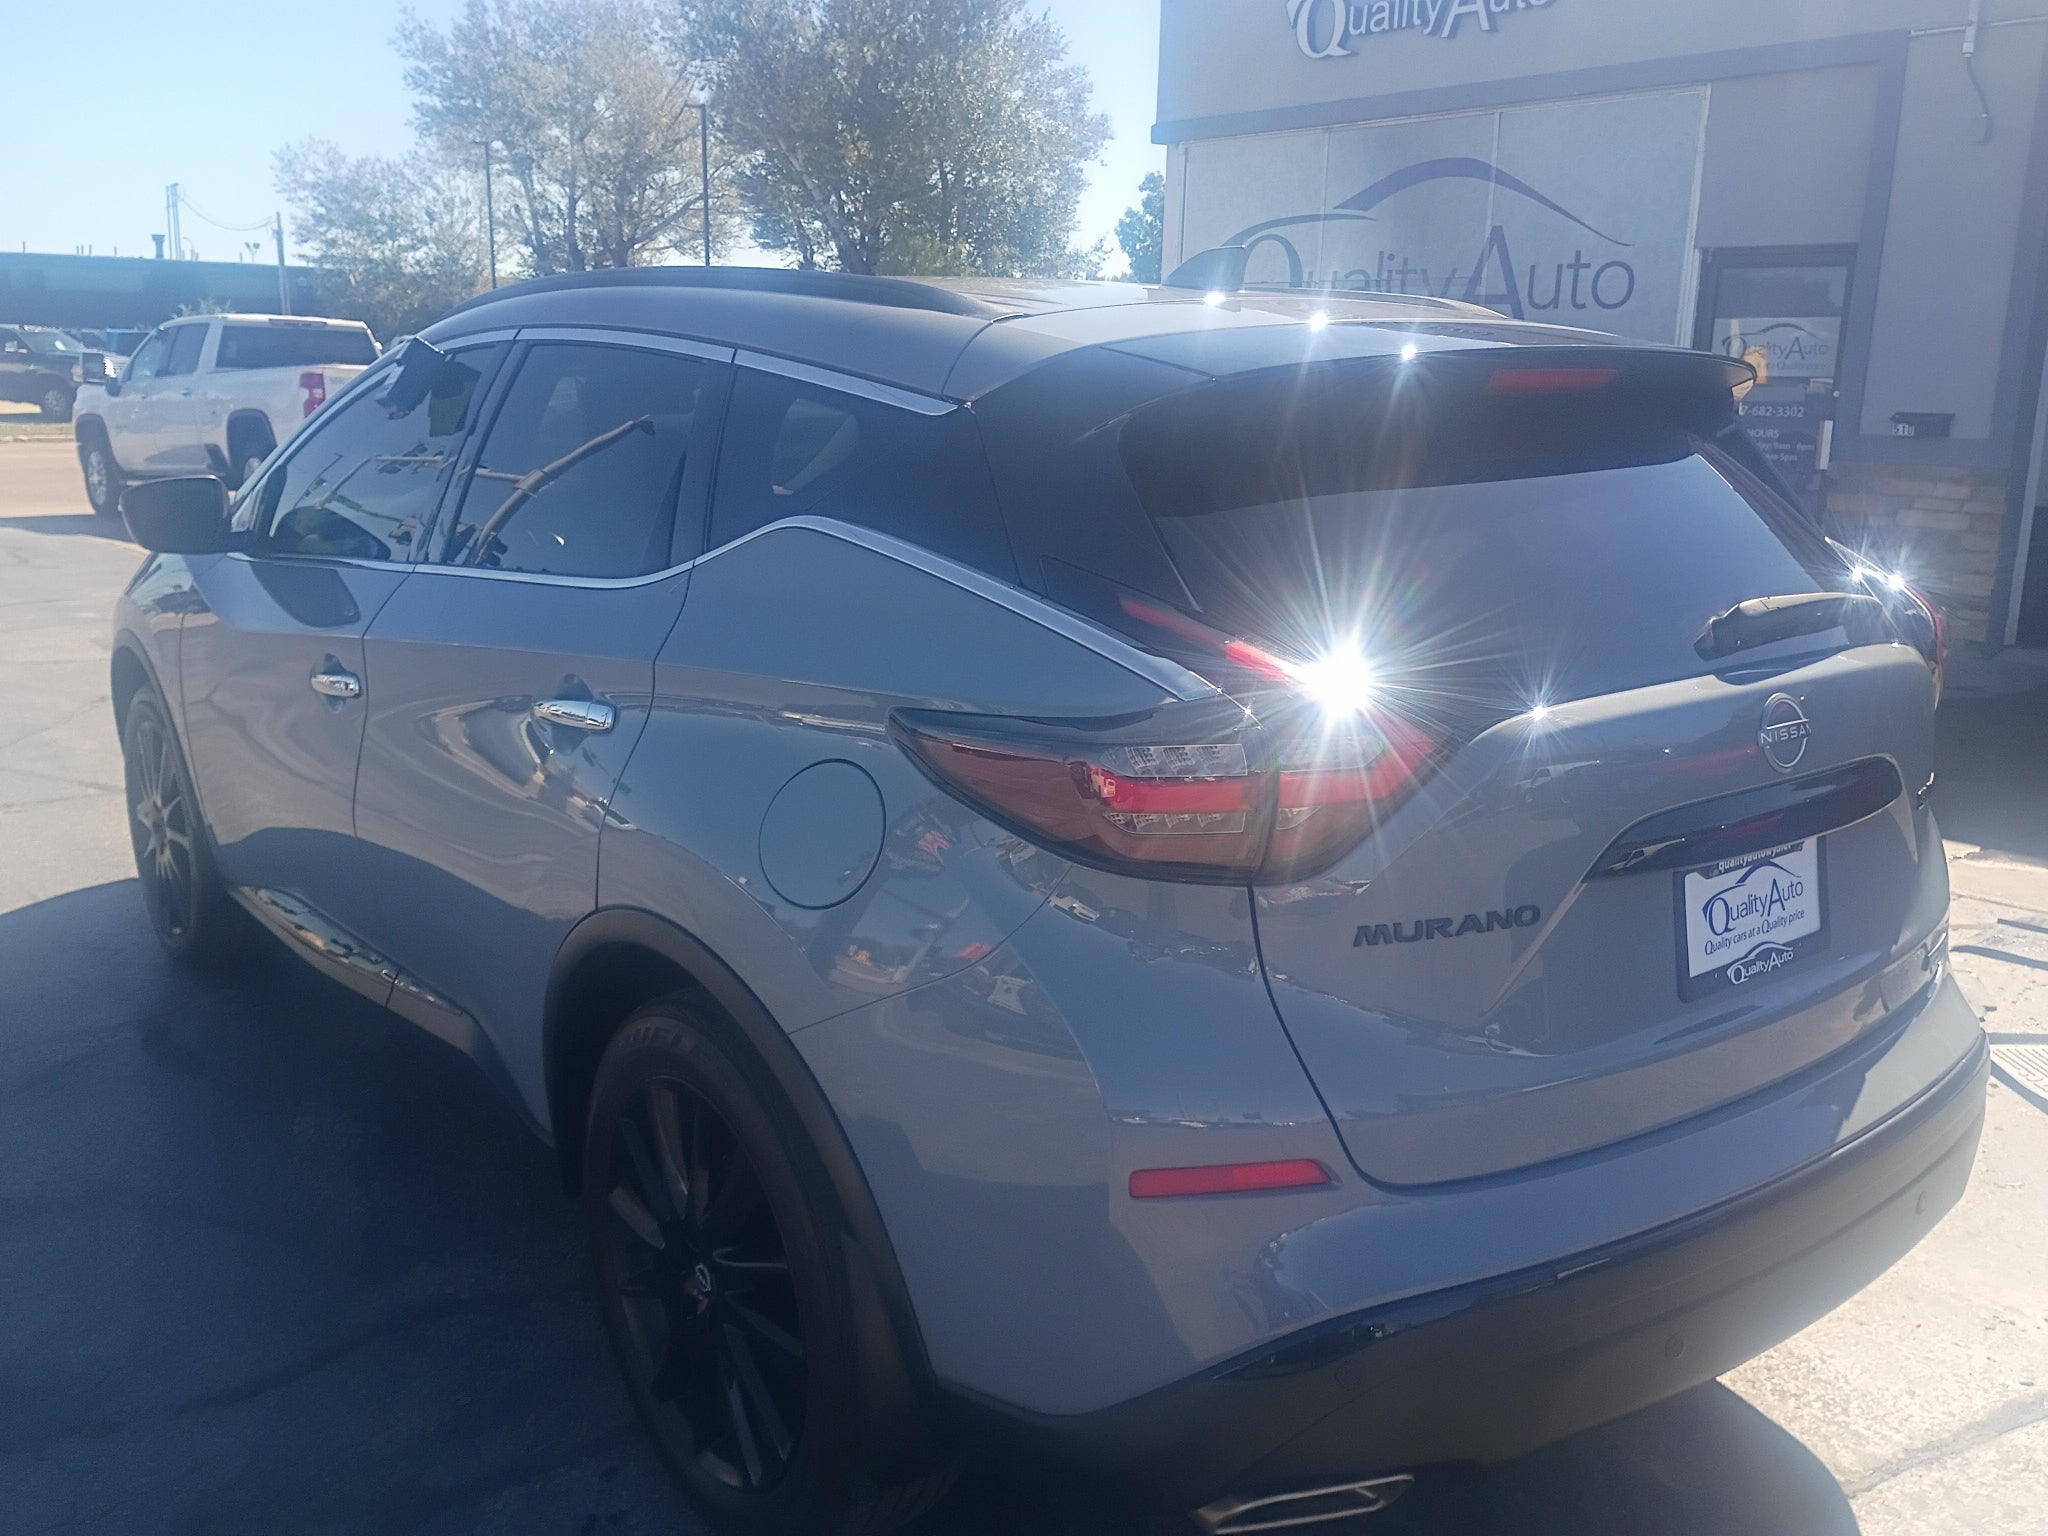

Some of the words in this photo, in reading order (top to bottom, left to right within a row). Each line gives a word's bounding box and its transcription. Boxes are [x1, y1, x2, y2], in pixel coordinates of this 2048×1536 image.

[1760, 724, 1811, 744] NISSAN
[1353, 904, 1541, 947] MURANO
[1705, 936, 1733, 955] Quality
[1733, 930, 1747, 944] cars
[1748, 927, 1756, 939] at
[1762, 915, 1788, 934] Quality
[1788, 909, 1805, 925] price
